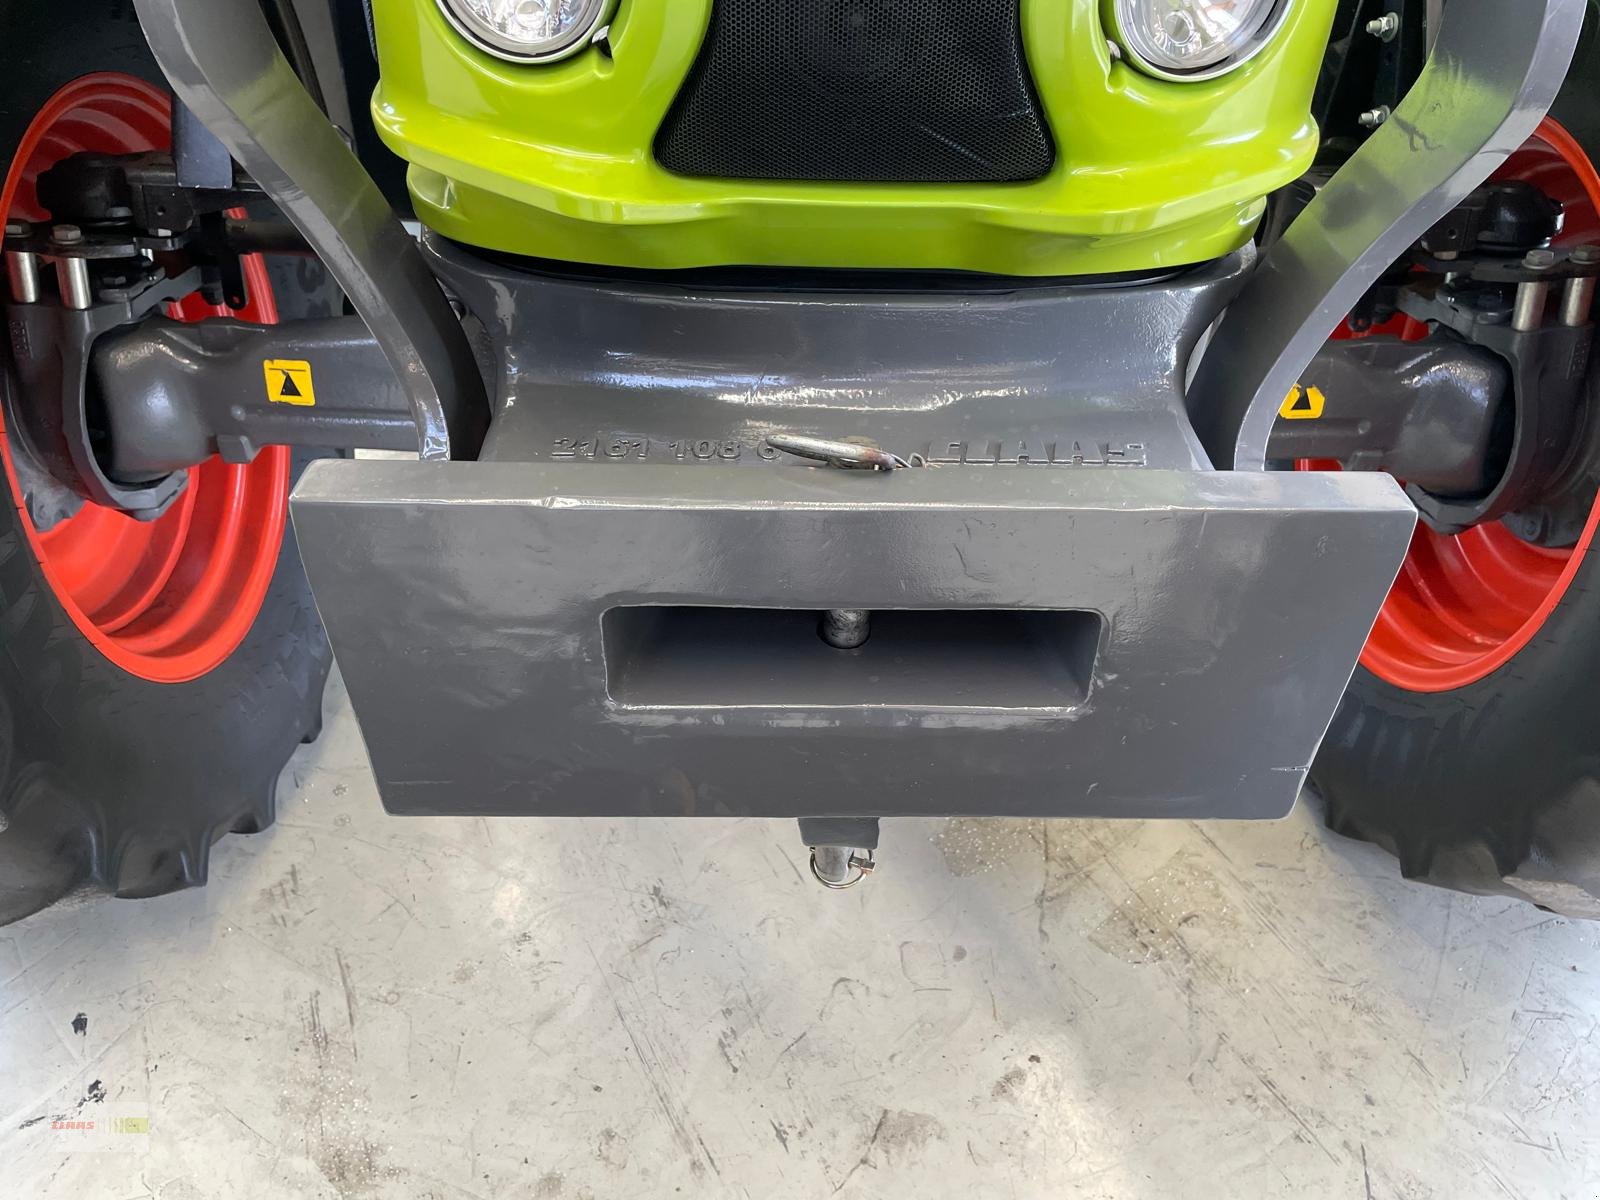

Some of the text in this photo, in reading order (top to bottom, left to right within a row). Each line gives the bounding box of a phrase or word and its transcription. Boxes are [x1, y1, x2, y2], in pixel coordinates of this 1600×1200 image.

[551, 437, 650, 459] 2161
[669, 439, 742, 460] 108
[926, 440, 1147, 466] CLAAS
